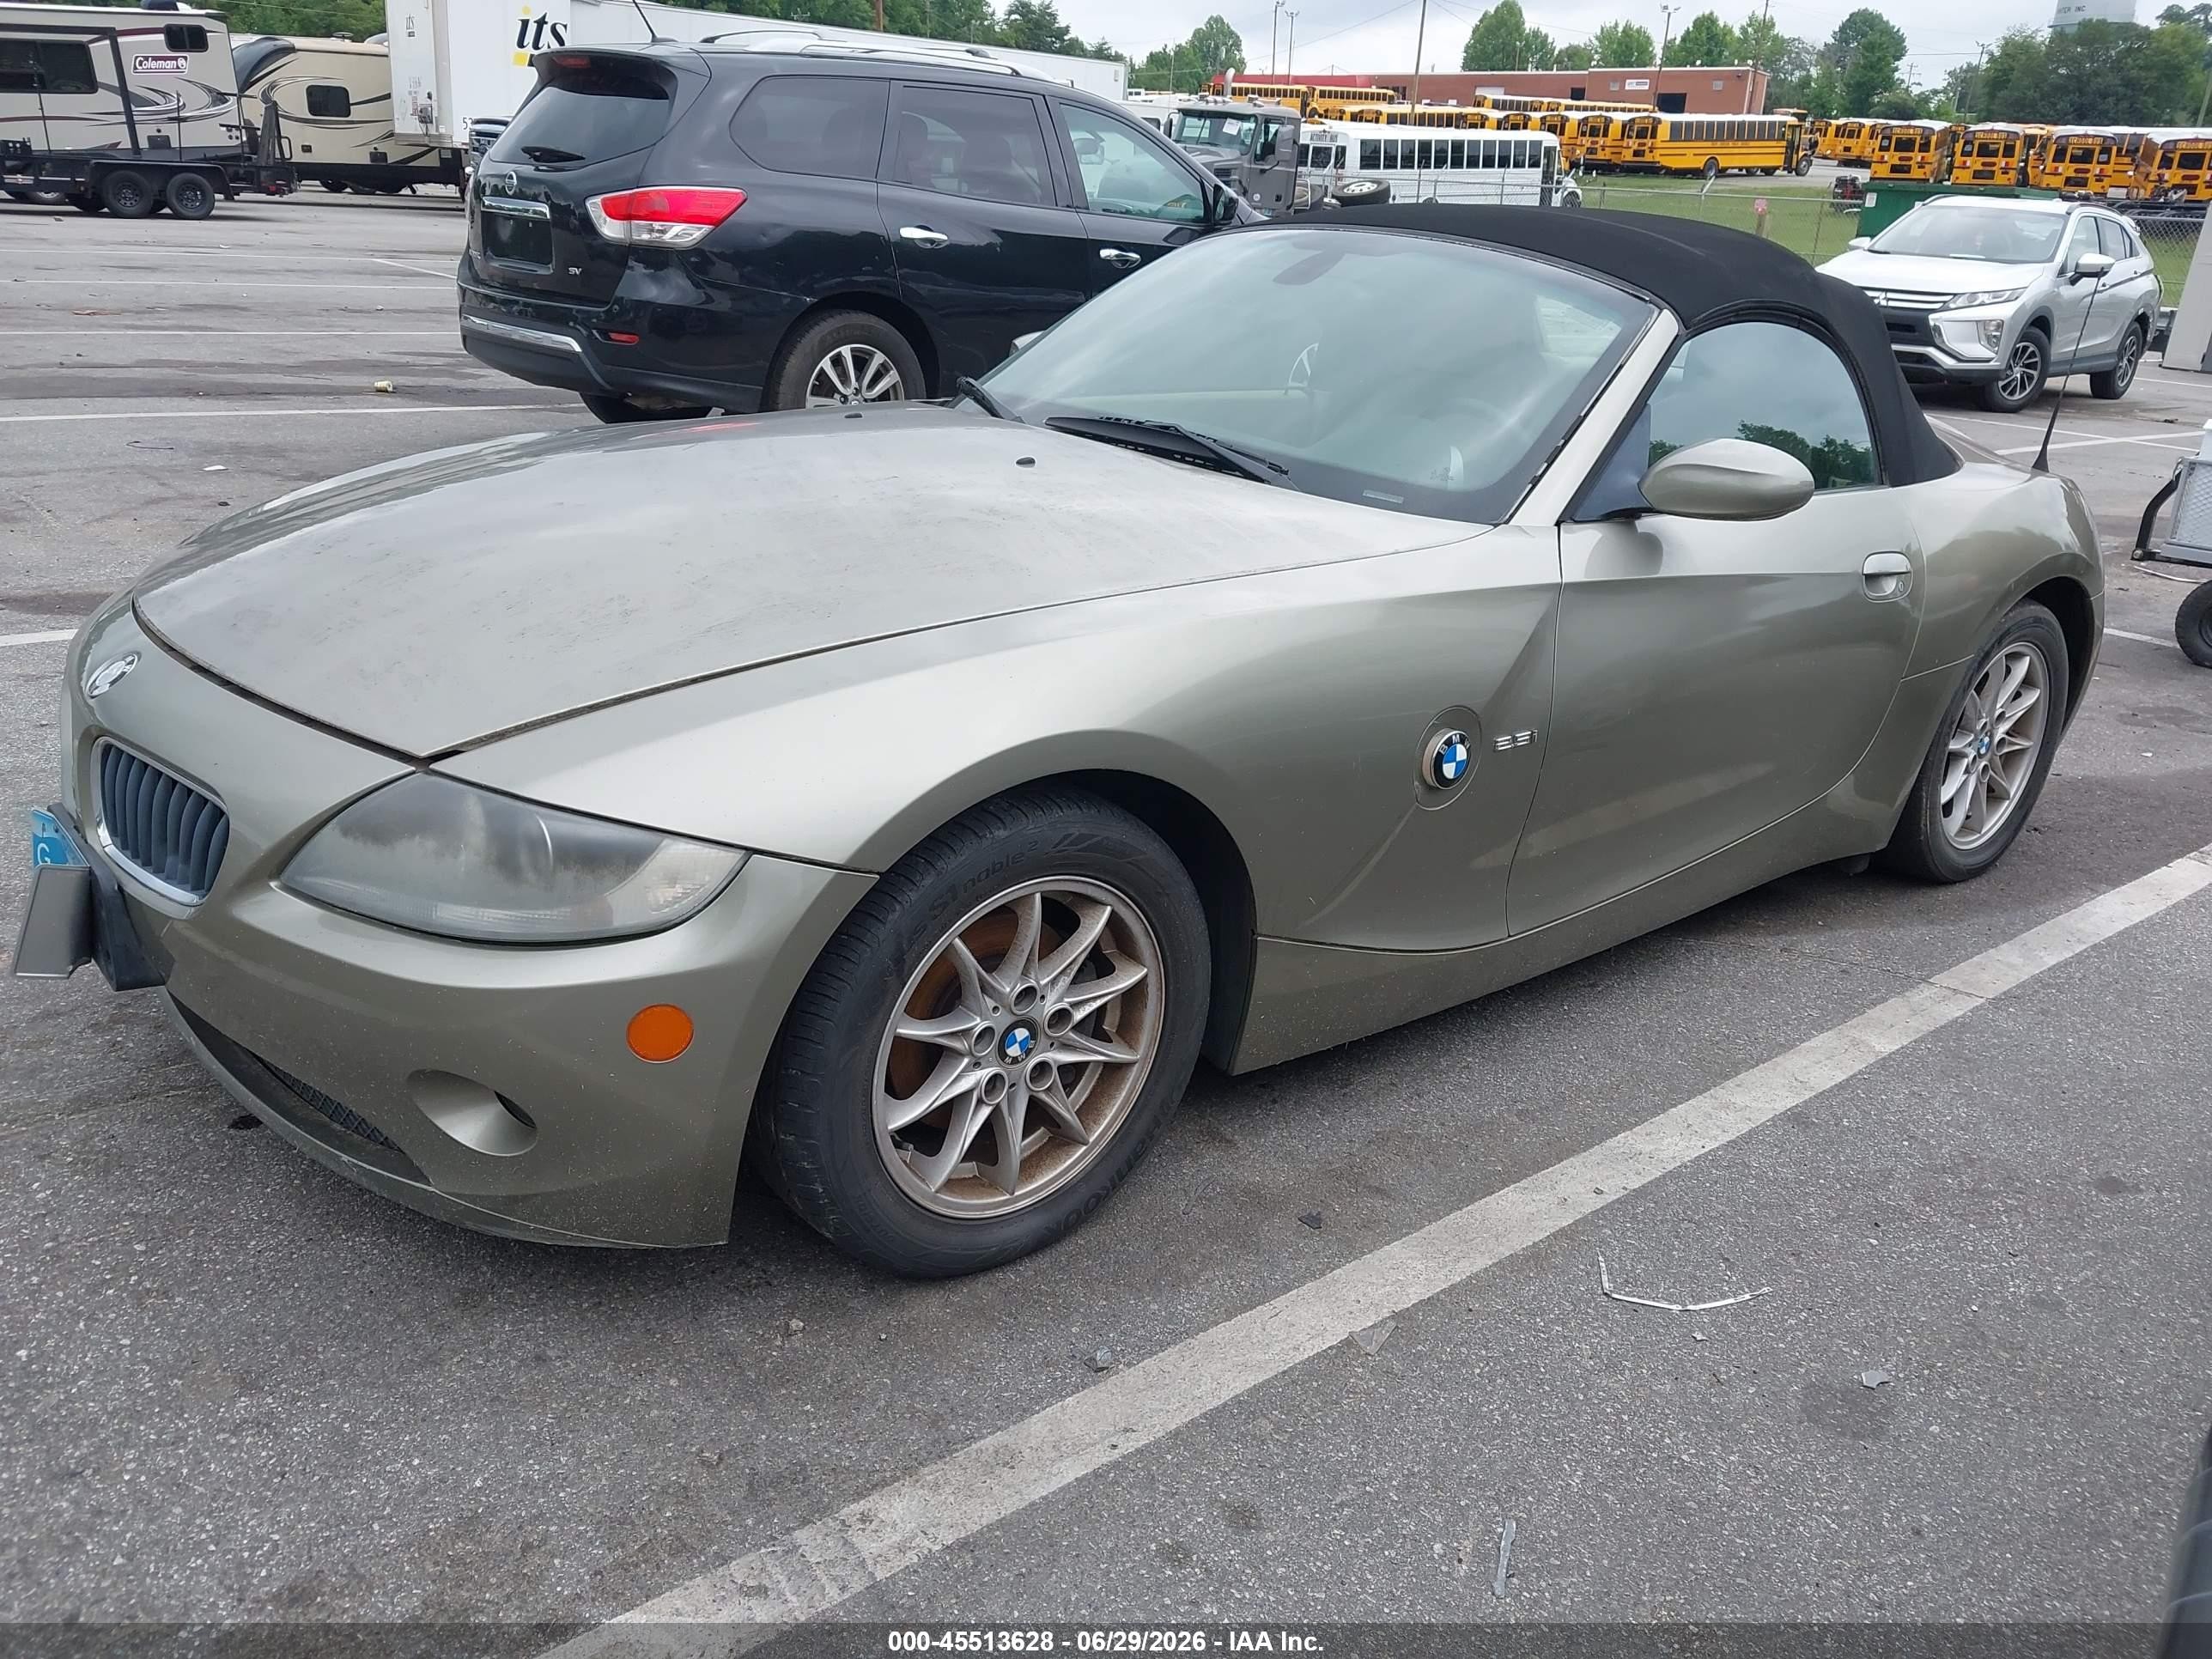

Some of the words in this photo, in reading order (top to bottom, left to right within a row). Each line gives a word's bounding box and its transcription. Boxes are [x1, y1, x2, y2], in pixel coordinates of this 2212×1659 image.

[516, 5, 568, 51] its
[136, 57, 177, 70] Coleman
[568, 267, 582, 276] SV
[1438, 733, 1471, 755] BMW
[1004, 1040, 1036, 1064] BMW
